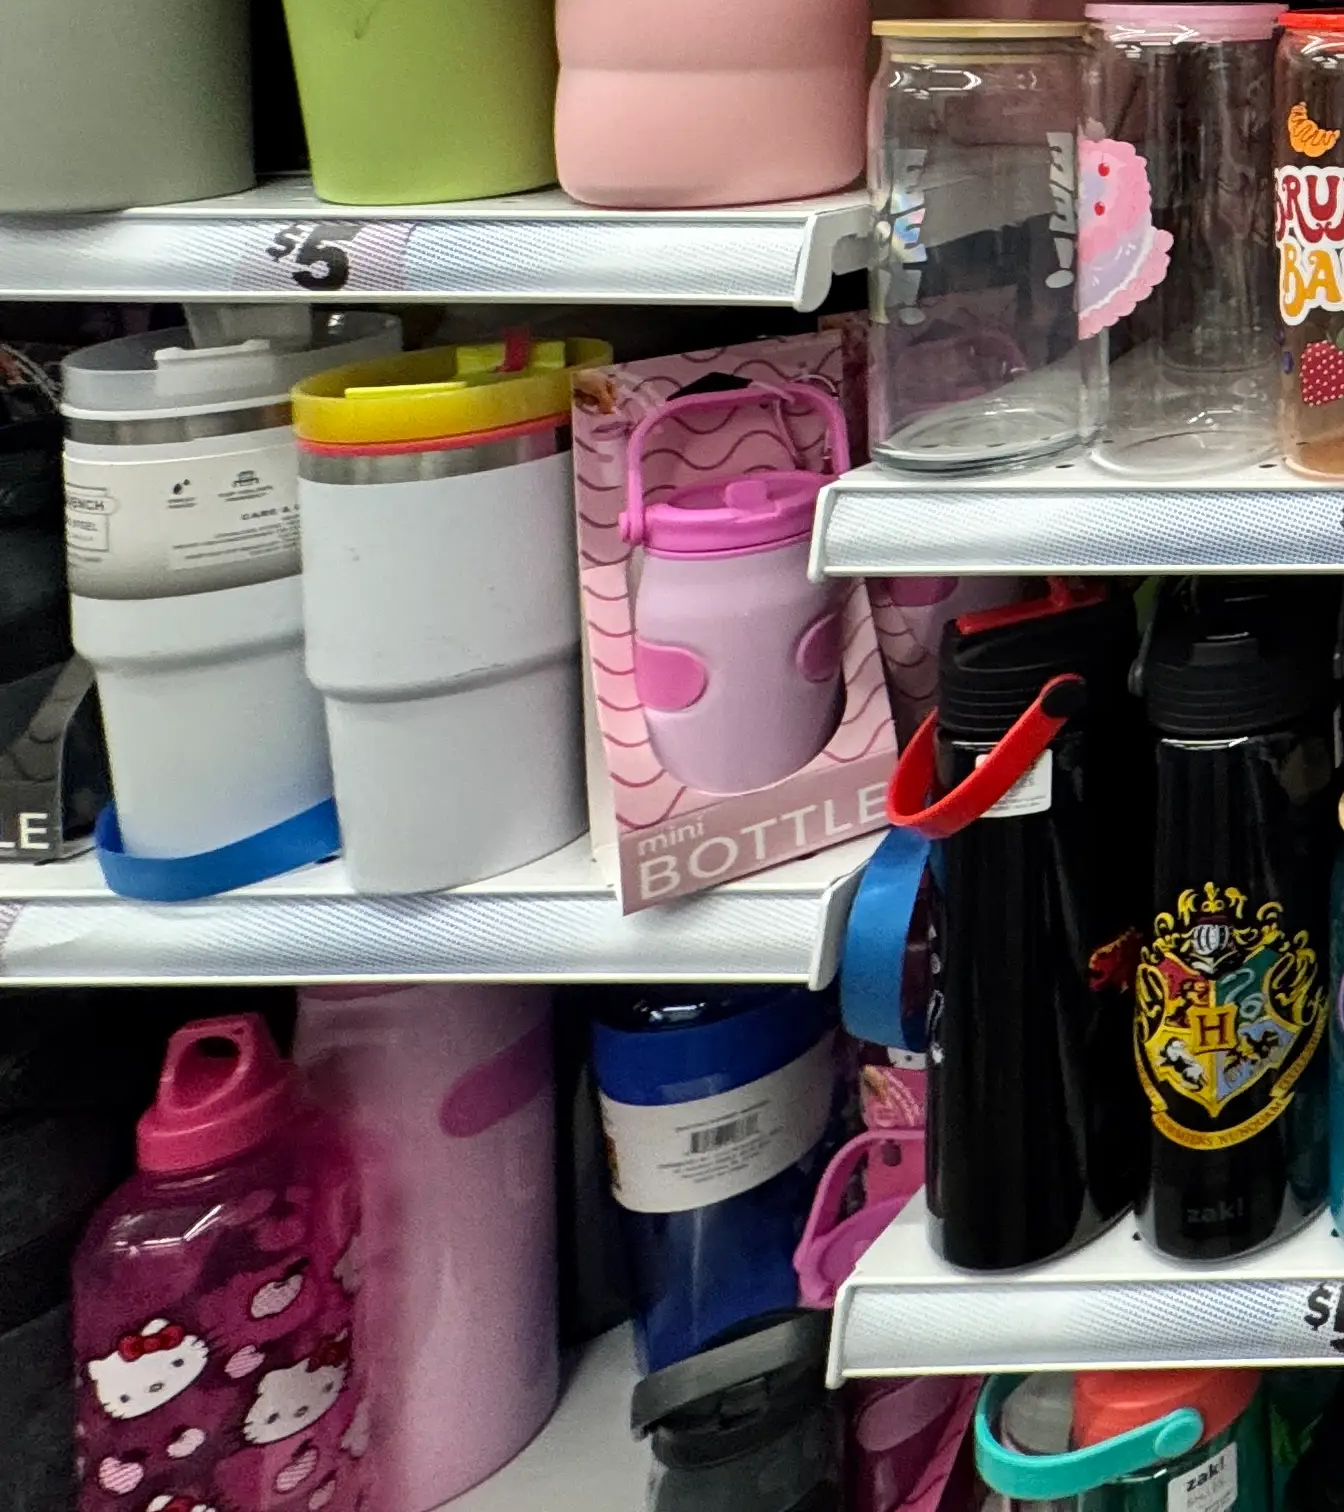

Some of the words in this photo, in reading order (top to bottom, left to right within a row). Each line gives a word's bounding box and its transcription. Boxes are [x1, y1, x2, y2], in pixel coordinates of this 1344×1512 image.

[265, 222, 366, 291] $5
[637, 815, 705, 856] mini
[639, 781, 888, 900] BOTTLE
[1195, 1013, 1228, 1045] H
[1186, 1455, 1226, 1493] zak!
